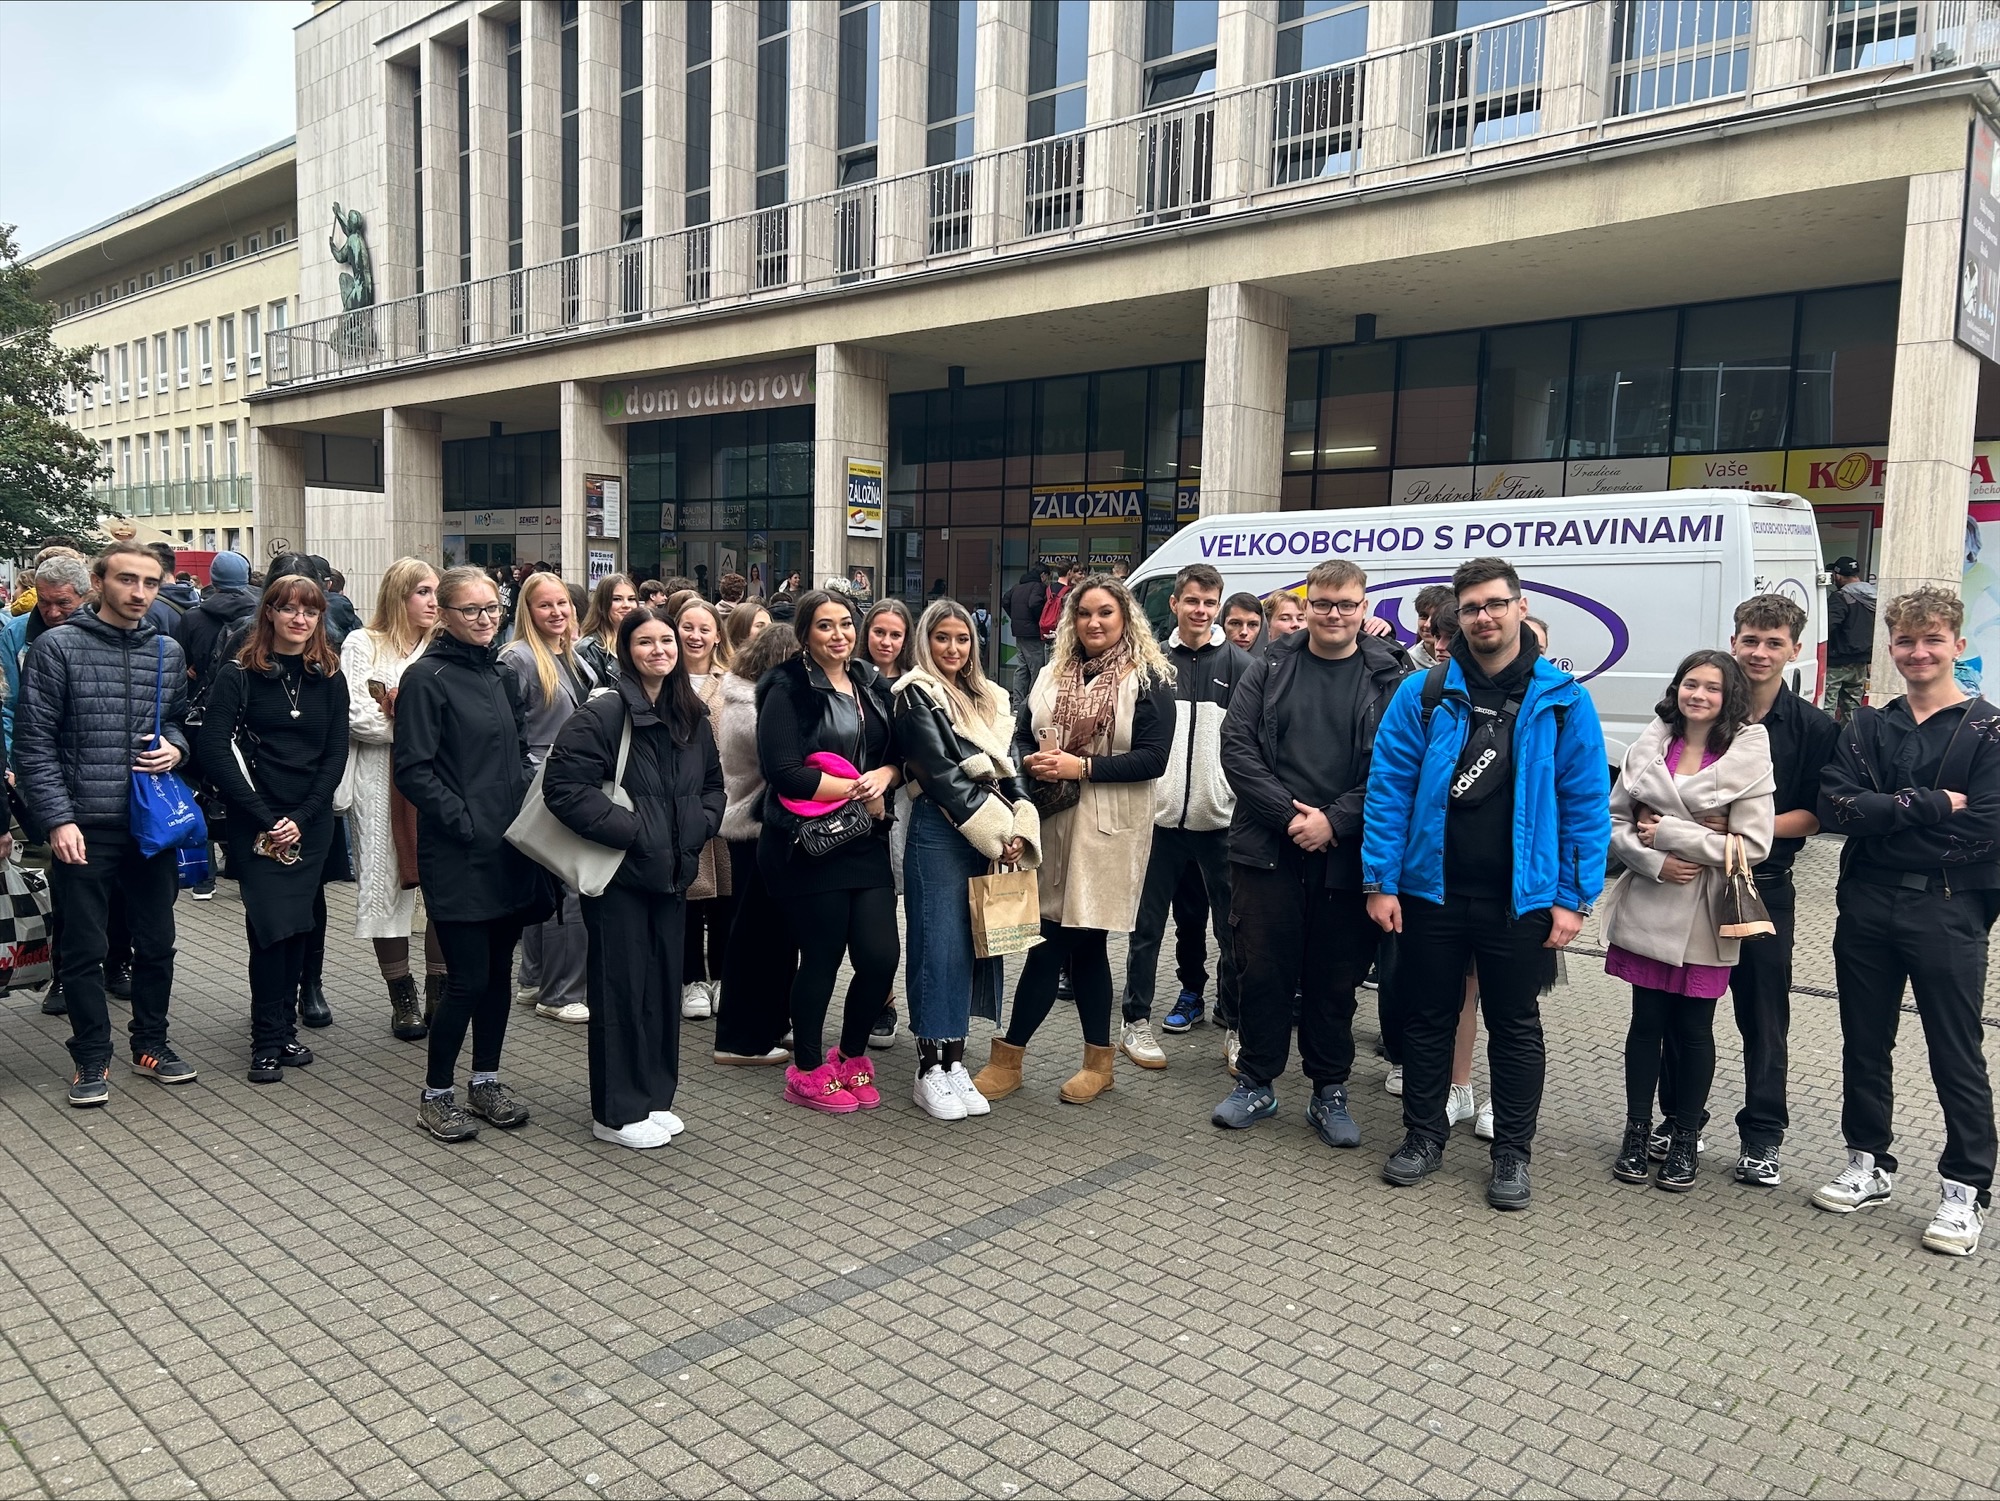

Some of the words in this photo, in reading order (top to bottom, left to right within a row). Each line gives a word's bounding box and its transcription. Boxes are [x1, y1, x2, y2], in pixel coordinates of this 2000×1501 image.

[625, 385, 679, 415] dom
[687, 373, 805, 409] odborov
[1569, 463, 1622, 478] Tradícia
[1704, 460, 1748, 477] Vaše
[849, 479, 881, 505] ZÁLOŽŇA
[1032, 489, 1141, 519] ZÁLOŽŇA
[1403, 480, 1483, 503] Pekáreň
[727, 504, 746, 514] ESTATE
[1200, 526, 1425, 557] VEĽKOOBCHOD
[1433, 525, 1454, 550] S
[1463, 514, 1725, 549] POTRAVINAMI
[1450, 748, 1497, 798] adidas
